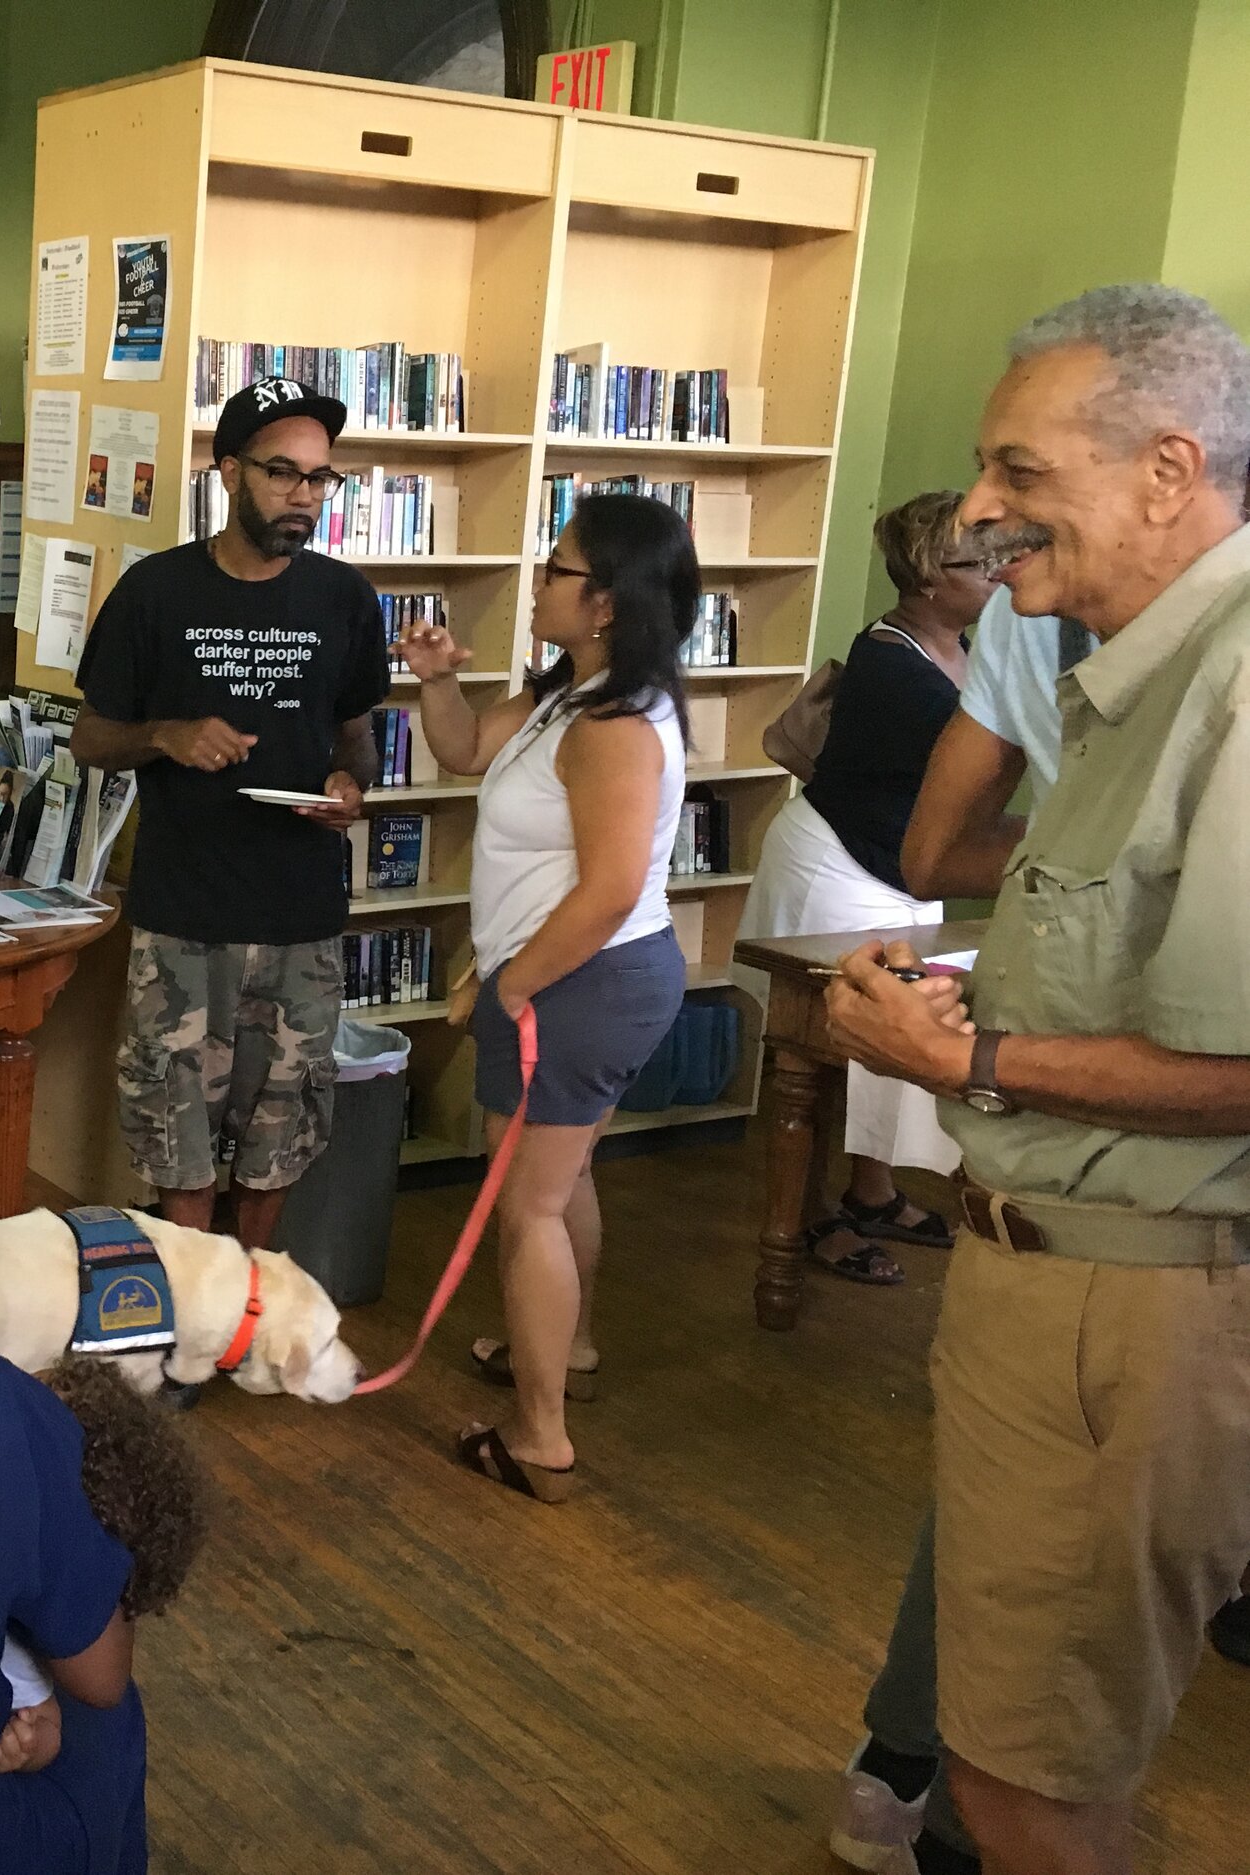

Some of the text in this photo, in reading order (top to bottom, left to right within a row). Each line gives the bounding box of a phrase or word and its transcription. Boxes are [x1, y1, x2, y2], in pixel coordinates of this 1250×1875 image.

[550, 47, 611, 111] EXIT
[125, 260, 160, 284] FOOTBALL
[133, 279, 155, 298] CHEER
[185, 627, 321, 645] across cultures,
[194, 643, 312, 663] darker people
[201, 661, 303, 679] suffer most.
[229, 681, 276, 700] why?
[390, 822, 413, 833] JOHN
[381, 832, 420, 842] GRISHAM
[380, 861, 395, 871] THE
[380, 870, 416, 880] OF TORTS
